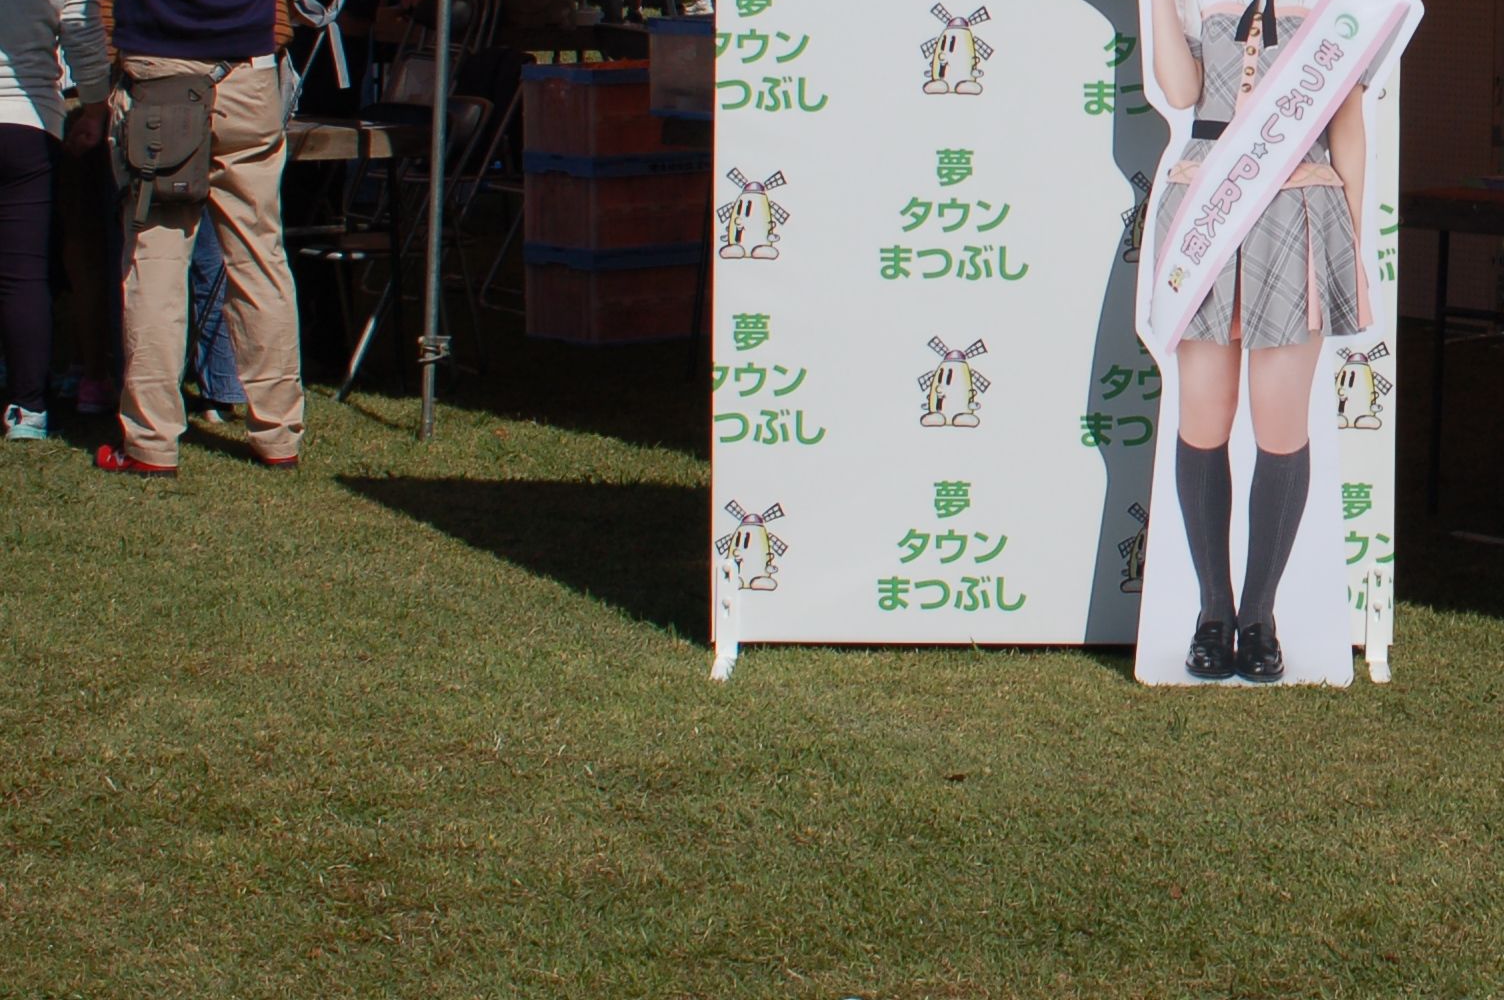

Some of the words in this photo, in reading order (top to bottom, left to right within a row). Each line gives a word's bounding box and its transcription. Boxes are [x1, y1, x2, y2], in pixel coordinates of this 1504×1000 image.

[1104, 32, 1136, 67] タ
[936, 148, 973, 185] 夢
[900, 198, 1010, 232] タウン
[880, 245, 1028, 281] まつぶし
[733, 313, 770, 351] 夢
[934, 482, 971, 519] 夢
[897, 529, 1007, 564] タウン
[877, 578, 1026, 612] まつぶし
